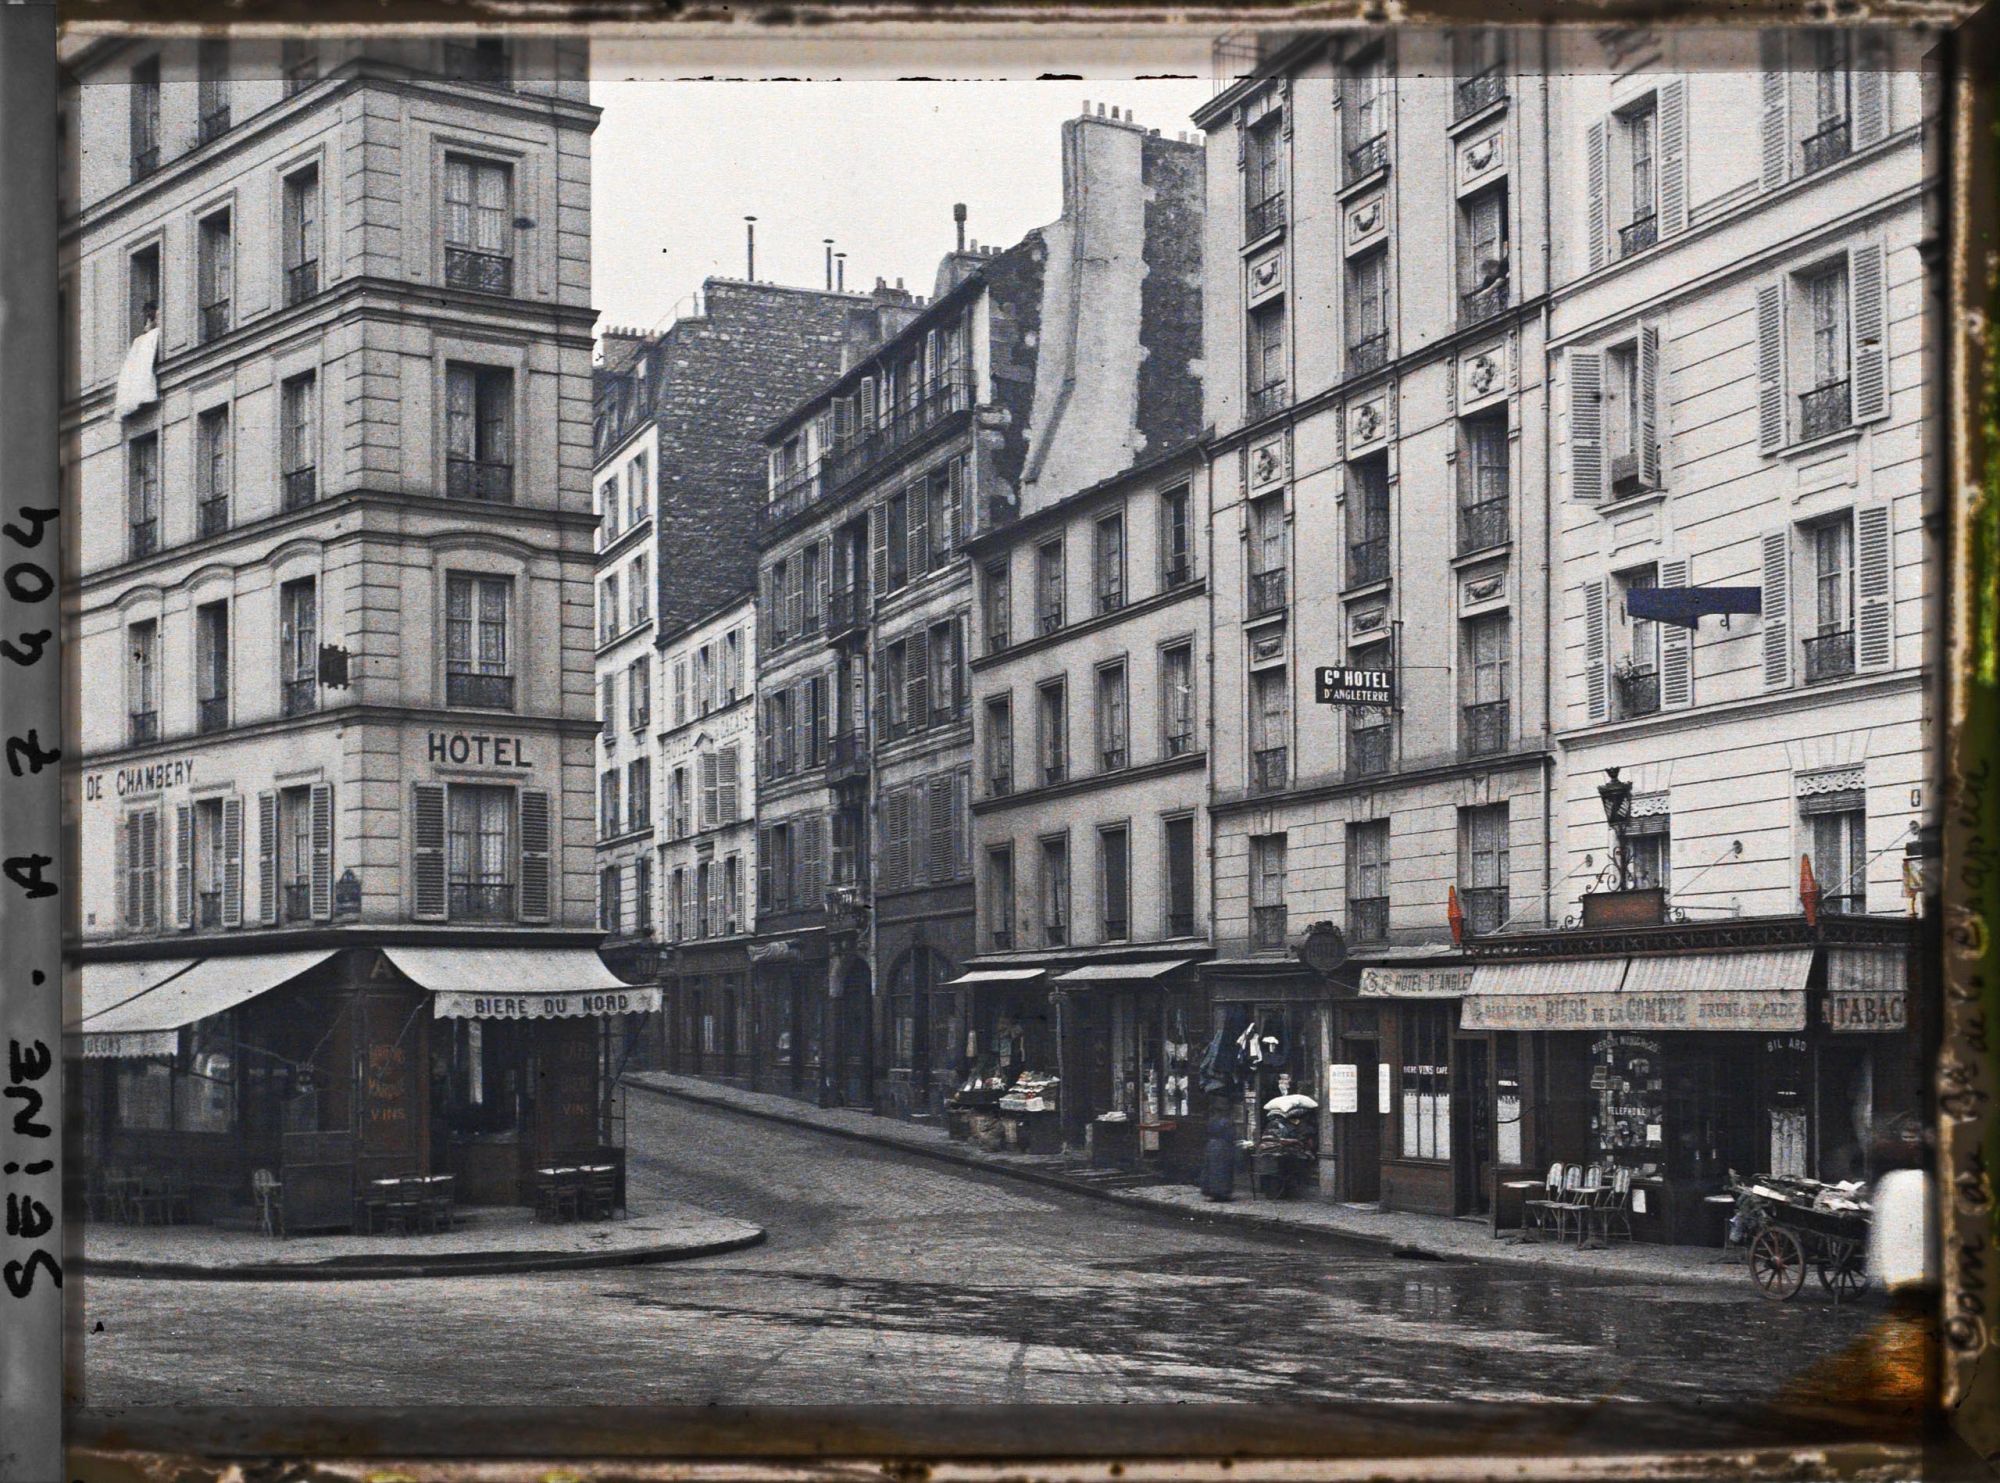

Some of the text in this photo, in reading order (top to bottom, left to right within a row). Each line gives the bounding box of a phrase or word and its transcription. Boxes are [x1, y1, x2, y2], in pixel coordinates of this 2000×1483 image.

[1344, 670, 1391, 689] HOTEL
[1324, 688, 1390, 702] D'ANGLETERRE
[86, 775, 104, 801] DE
[2, 852, 59, 900] A
[544, 998, 567, 1013] DU
[582, 994, 629, 1012] NORD
[1837, 998, 1905, 1023] TABAC
[370, 1107, 406, 1121] VINS
